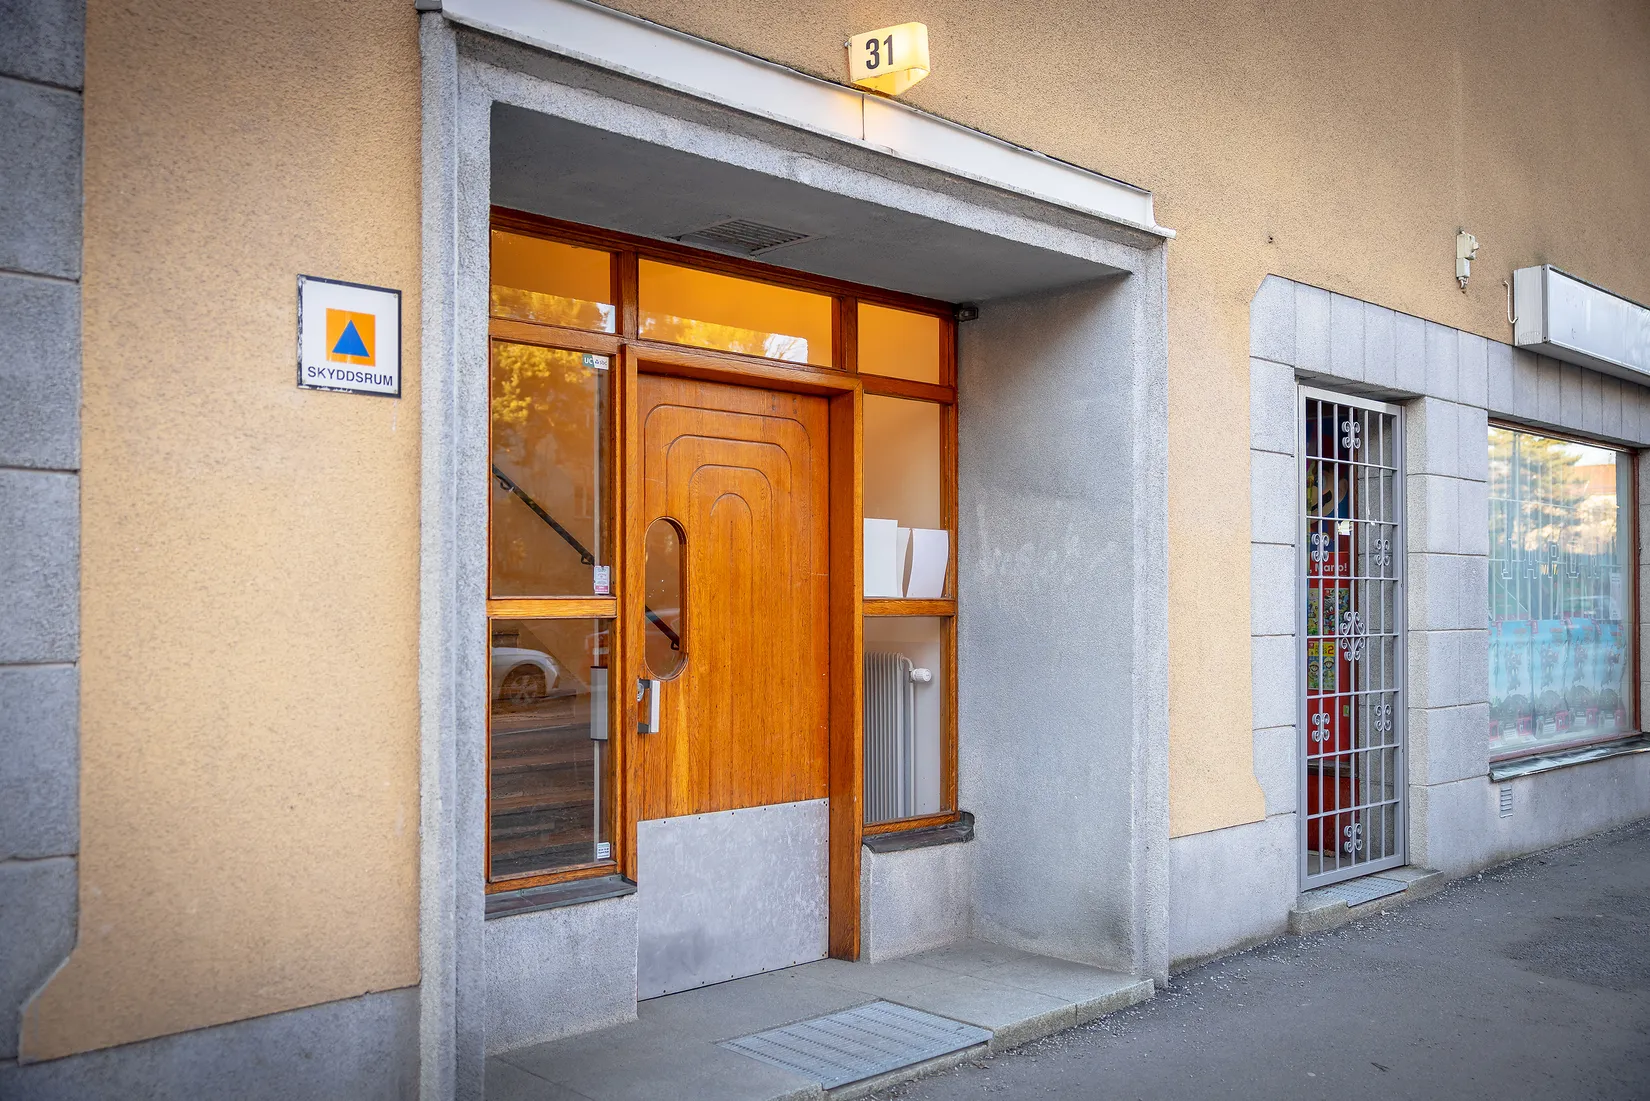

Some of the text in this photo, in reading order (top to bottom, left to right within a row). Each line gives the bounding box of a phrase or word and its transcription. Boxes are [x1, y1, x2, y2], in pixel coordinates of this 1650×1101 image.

[866, 34, 894, 69] 31
[584, 357, 593, 365] UC
[307, 366, 394, 386] SKYDDSRUM
[1315, 563, 1347, 572] aro!
[1327, 645, 1334, 655] 2
